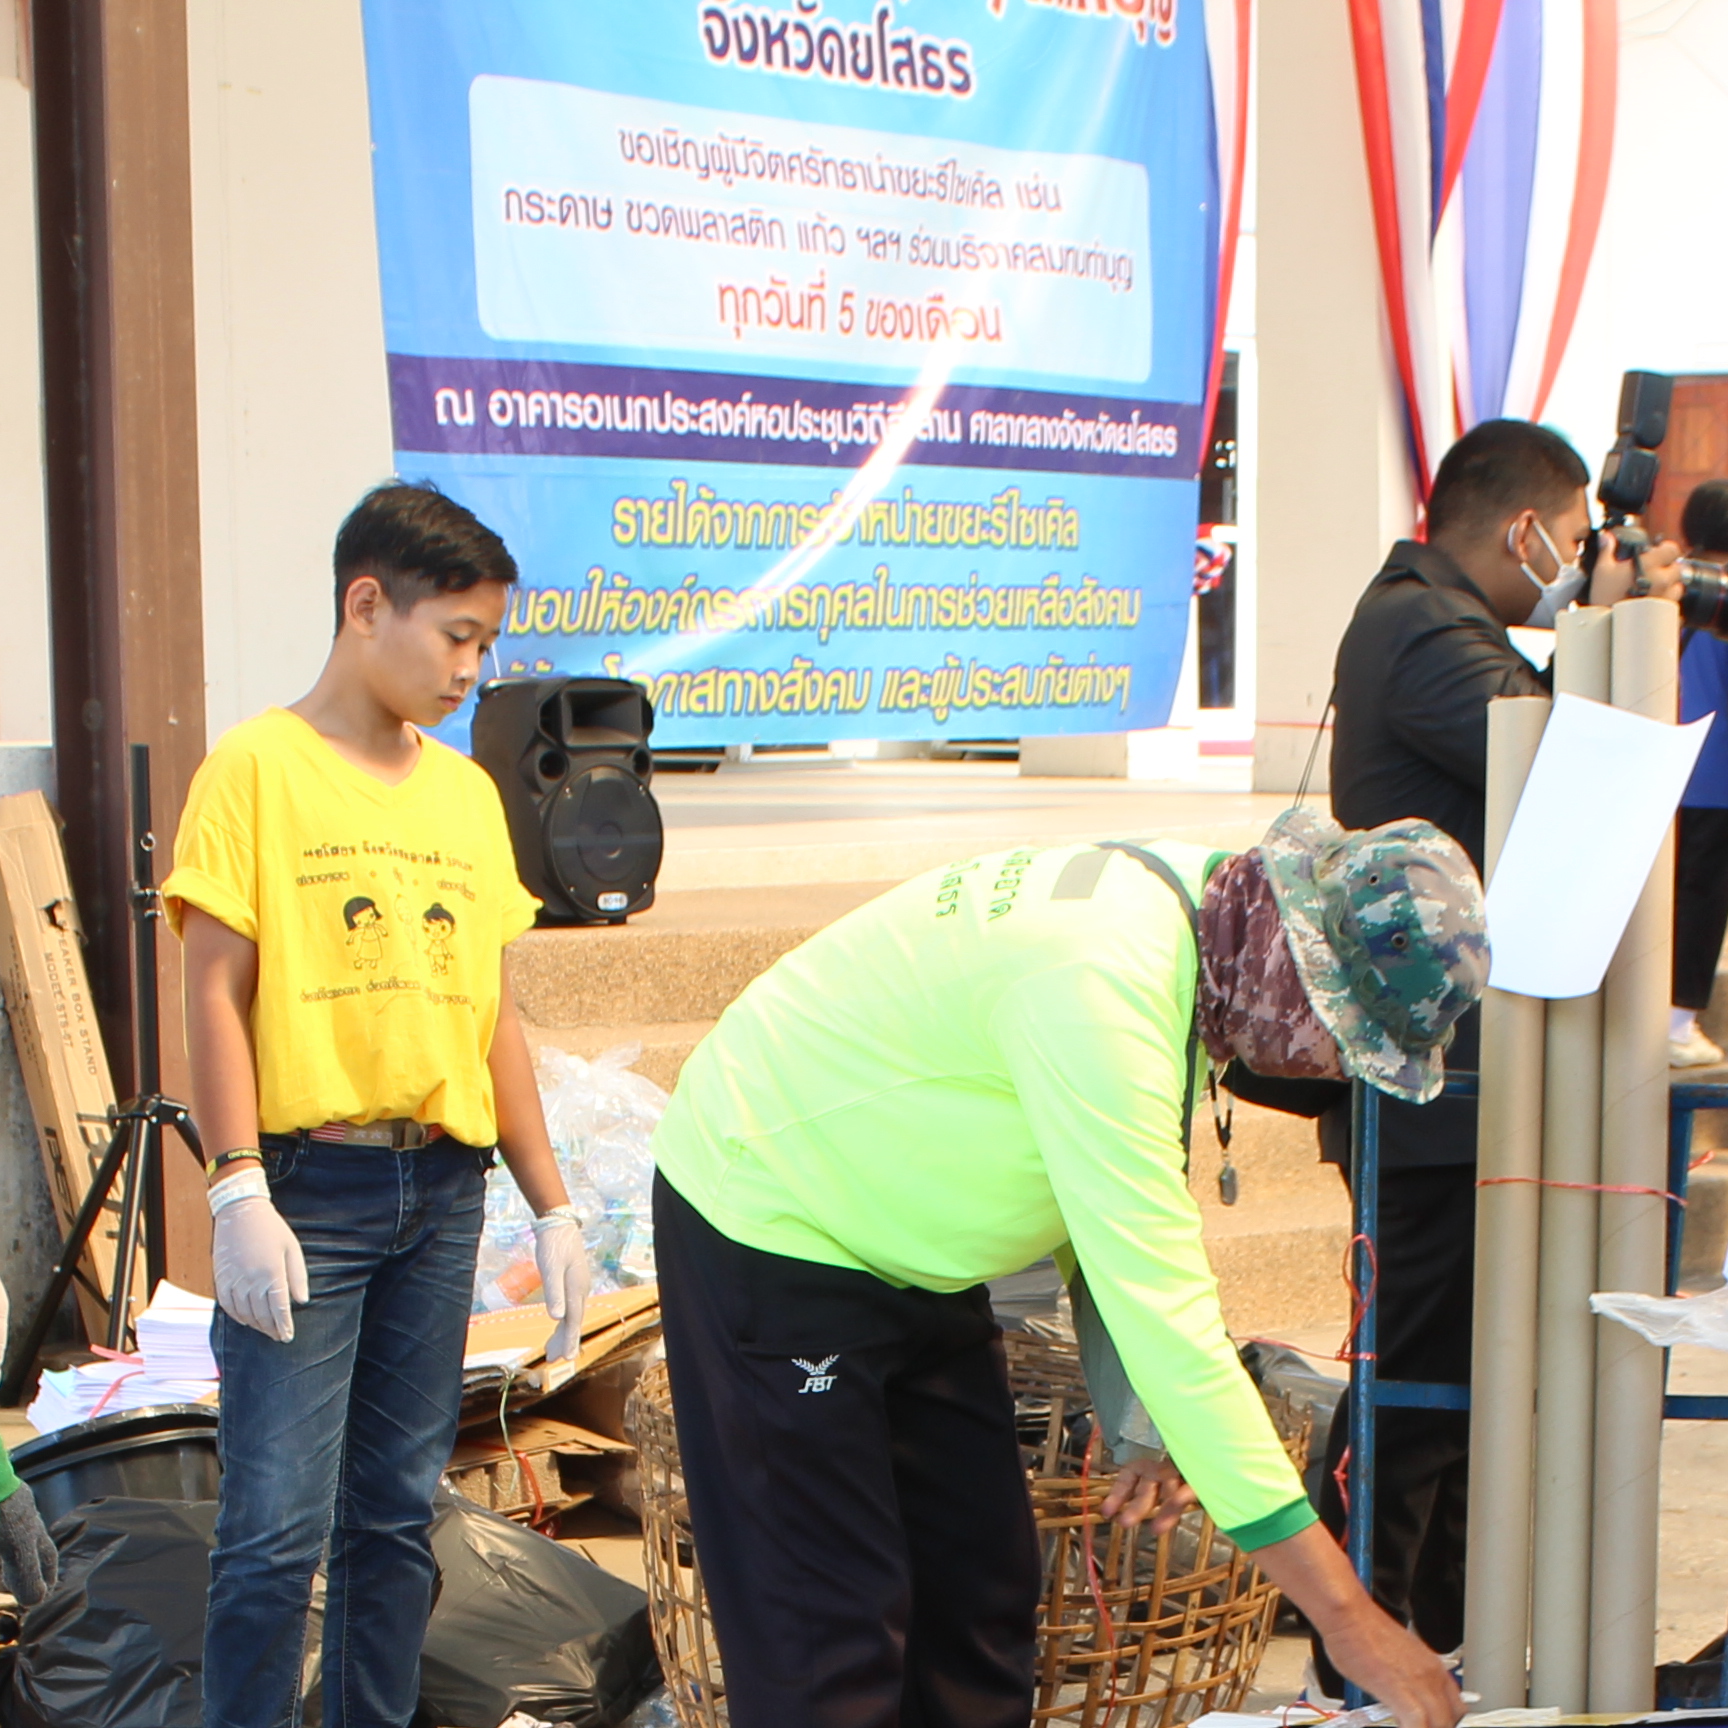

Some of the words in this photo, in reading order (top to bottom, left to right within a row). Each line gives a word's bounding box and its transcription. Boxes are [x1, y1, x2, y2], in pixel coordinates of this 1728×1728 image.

[504, 187, 614, 231] กระดาษ
[625, 200, 787, 250] ขวดพลาสติก
[798, 212, 846, 256] แก้ว
[719, 269, 826, 340] ทุกวันที่
[839, 291, 855, 336] 5
[434, 385, 475, 425] ณ
[72, 992, 87, 1026] BOX
[79, 1028, 99, 1077] STAND
[798, 1374, 839, 1394] FBT
